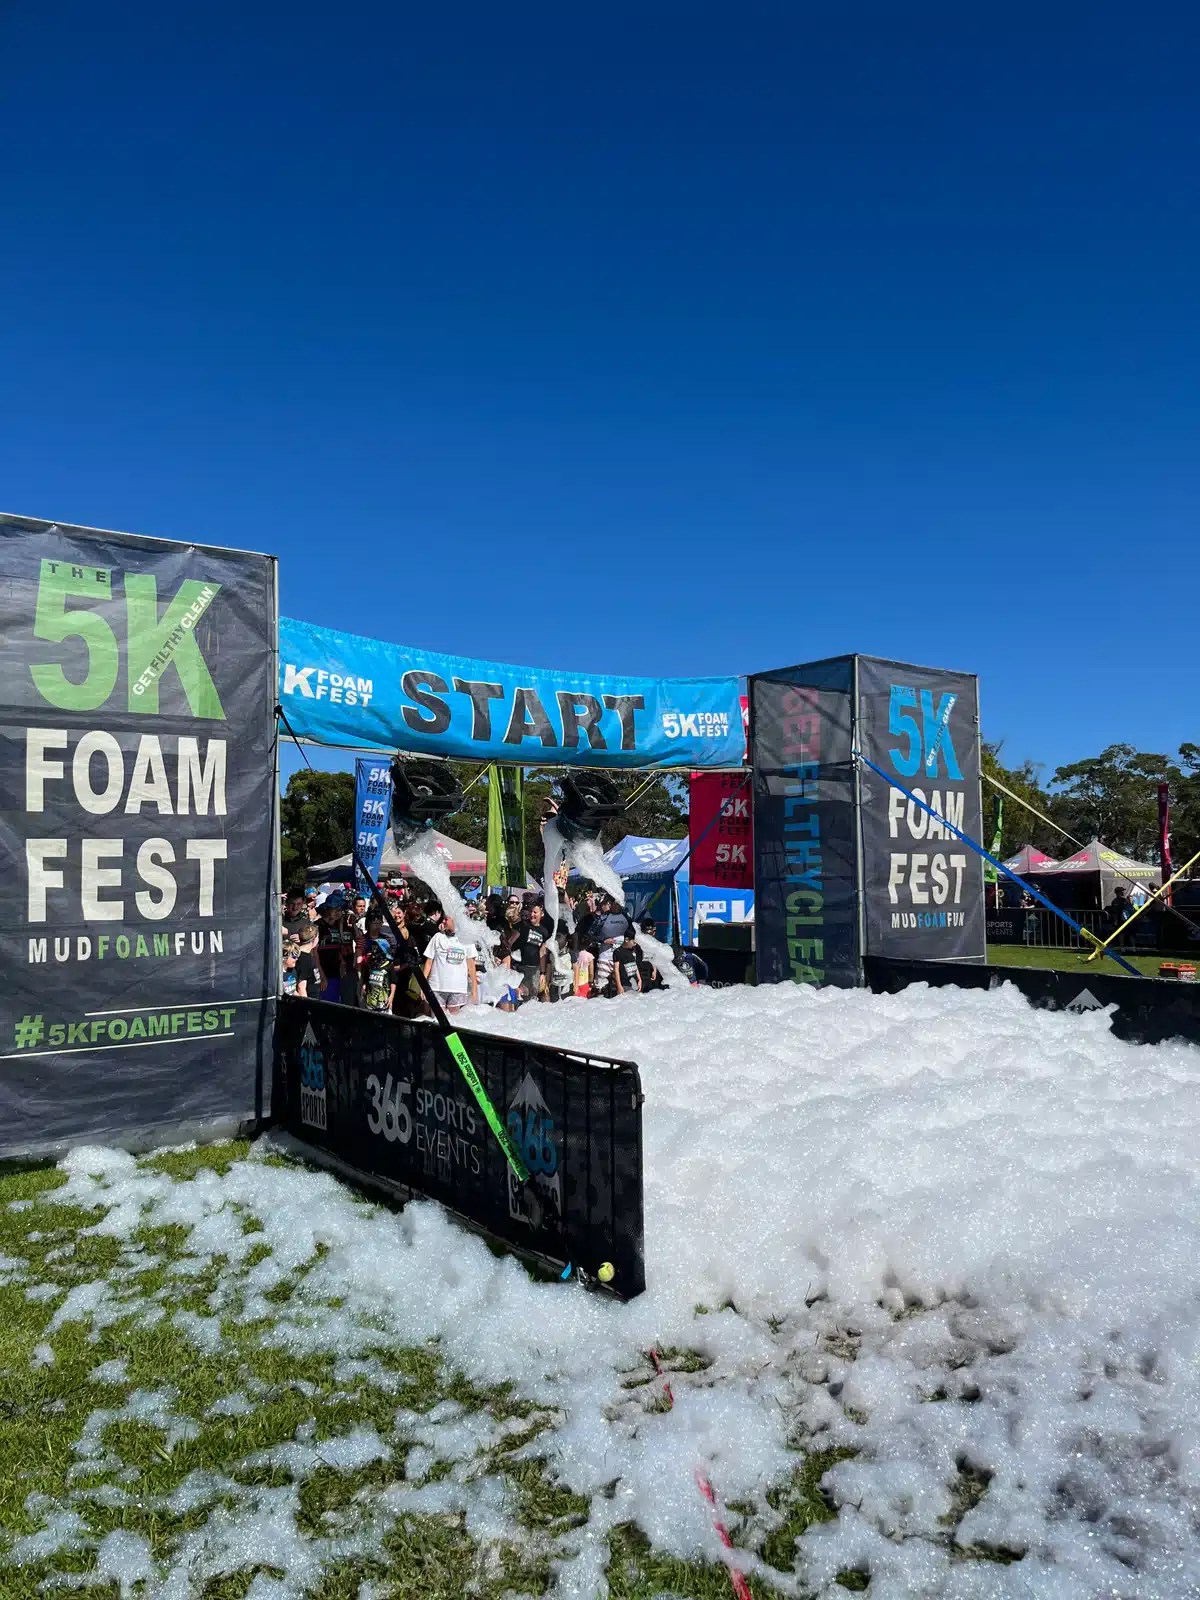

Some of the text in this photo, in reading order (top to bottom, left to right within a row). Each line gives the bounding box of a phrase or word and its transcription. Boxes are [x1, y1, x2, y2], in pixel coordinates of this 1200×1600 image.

[48, 563, 107, 583] THE
[29, 558, 227, 720] 5K
[278, 662, 317, 699] K
[317, 669, 373, 693] FOAM
[315, 685, 373, 707] FEST
[400, 669, 645, 751] START
[662, 712, 699, 738] 5K
[699, 712, 728, 724] FOAM
[699, 725, 728, 736] FEST
[888, 684, 964, 780] 5K
[26, 727, 228, 815] FOAM
[368, 767, 392, 783] 5K
[366, 787, 389, 795] FEST
[361, 813, 384, 821] FOAM
[362, 800, 386, 815] 5K
[719, 797, 750, 817] 5K
[888, 786, 964, 840] FOAM
[360, 819, 383, 827] FEST
[783, 687, 825, 984] GETFILTHYCLEA
[357, 832, 380, 847] 5K
[715, 843, 748, 863] 5K
[27, 837, 228, 922] FEST
[888, 853, 966, 904] FEST
[891, 911, 965, 929] MUDFOAMFUN
[28, 930, 225, 964] MUDFOAMFUN
[15, 1008, 236, 1049] #5KFOAMFEST
[366, 1072, 476, 1144] 365 SPORTS
[416, 1123, 481, 1175] EVENTS
